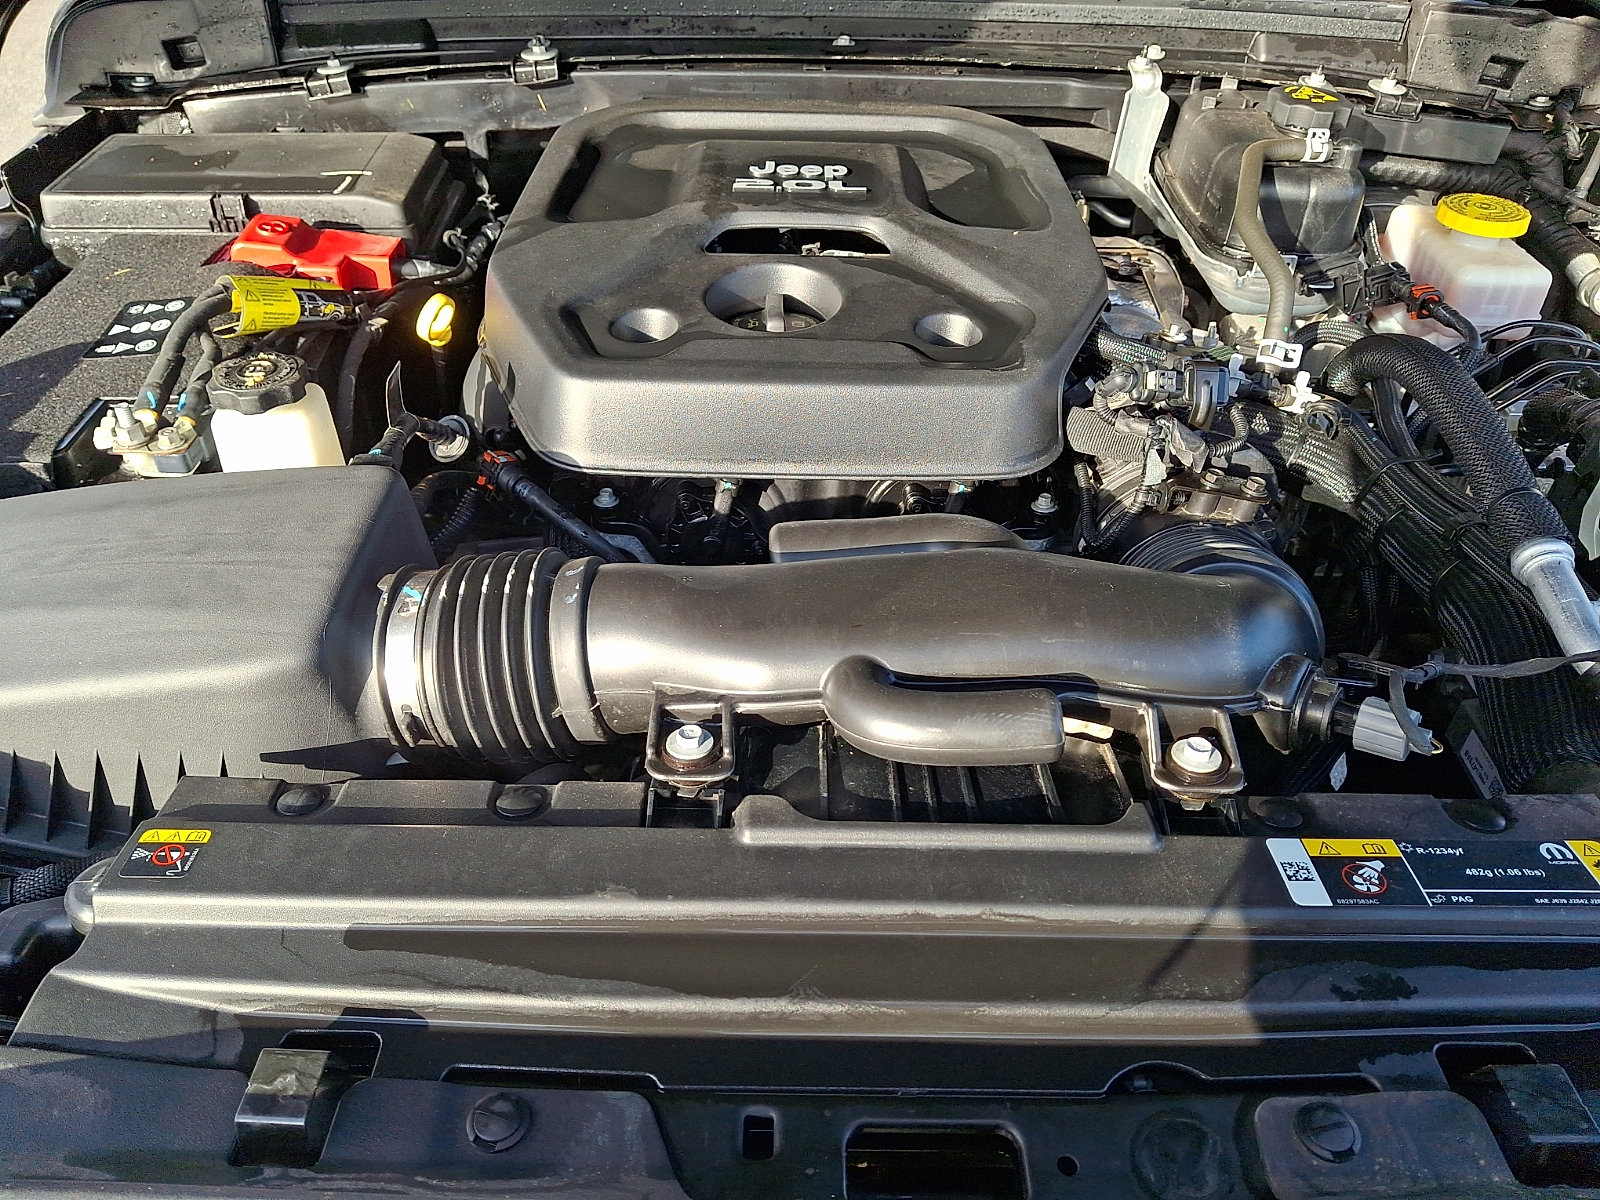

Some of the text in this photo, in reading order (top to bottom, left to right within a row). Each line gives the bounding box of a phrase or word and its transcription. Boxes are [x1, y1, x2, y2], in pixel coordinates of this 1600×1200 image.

[749, 160, 848, 181] Jeep
[732, 178, 867, 194] 2.0L
[1415, 847, 1464, 856] R-1234yf
[1465, 868, 1546, 878] 482g (1.06 lbs)
[1451, 895, 1474, 903] PAG
